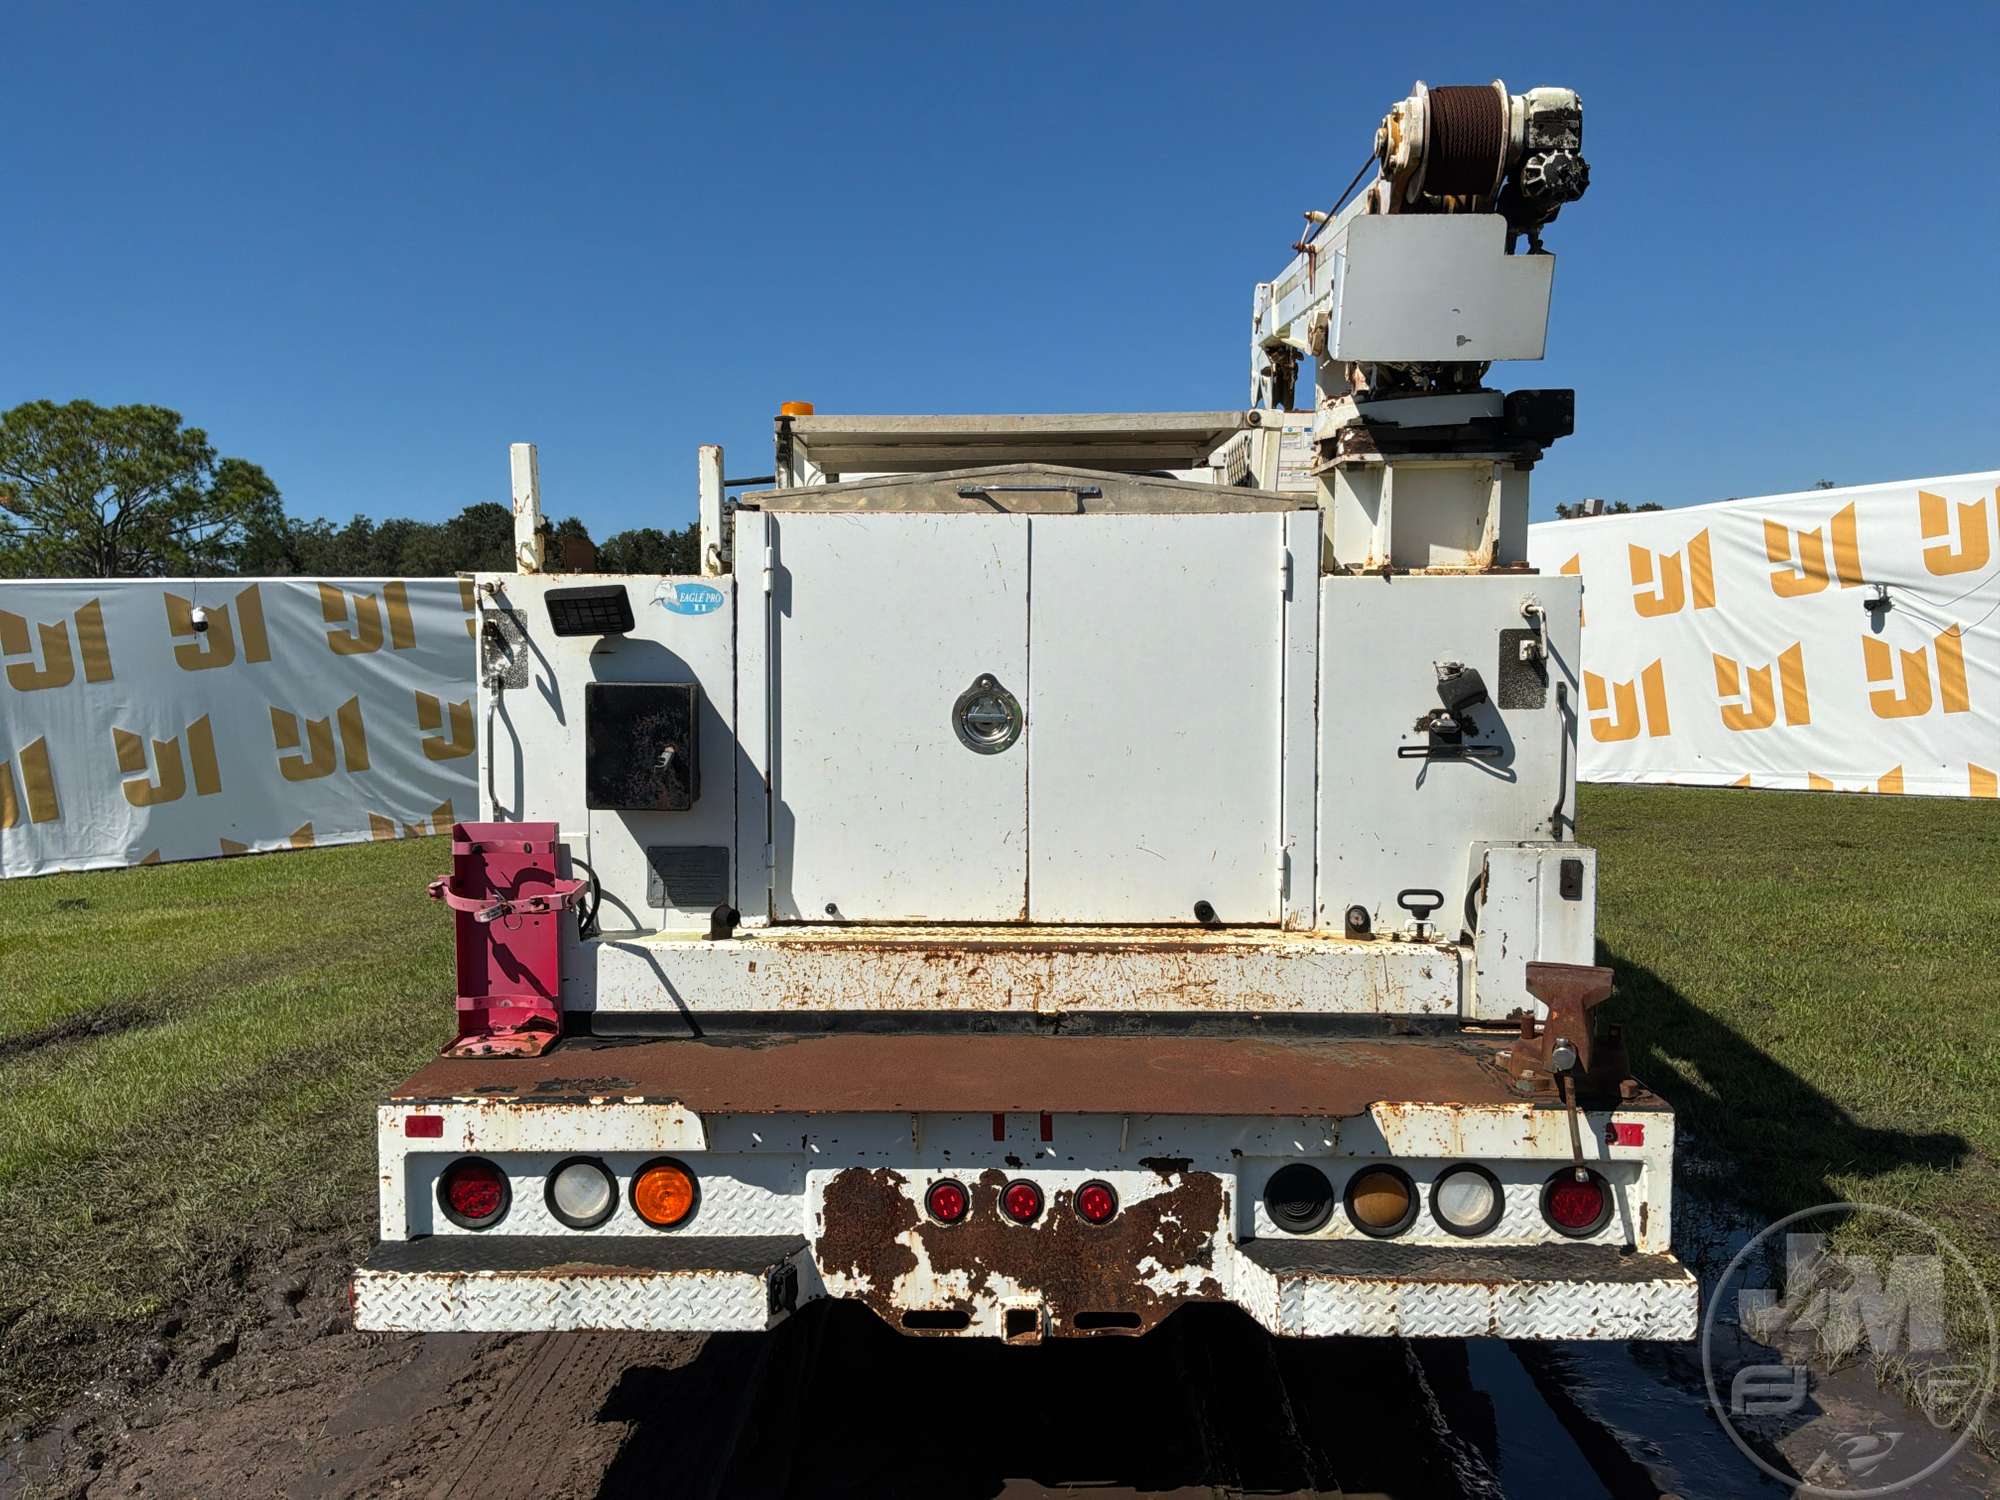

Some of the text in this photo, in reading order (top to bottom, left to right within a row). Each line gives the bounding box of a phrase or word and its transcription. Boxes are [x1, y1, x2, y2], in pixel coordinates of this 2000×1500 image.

[679, 592, 721, 603] EAGLE PRO
[694, 603, 706, 612] II
